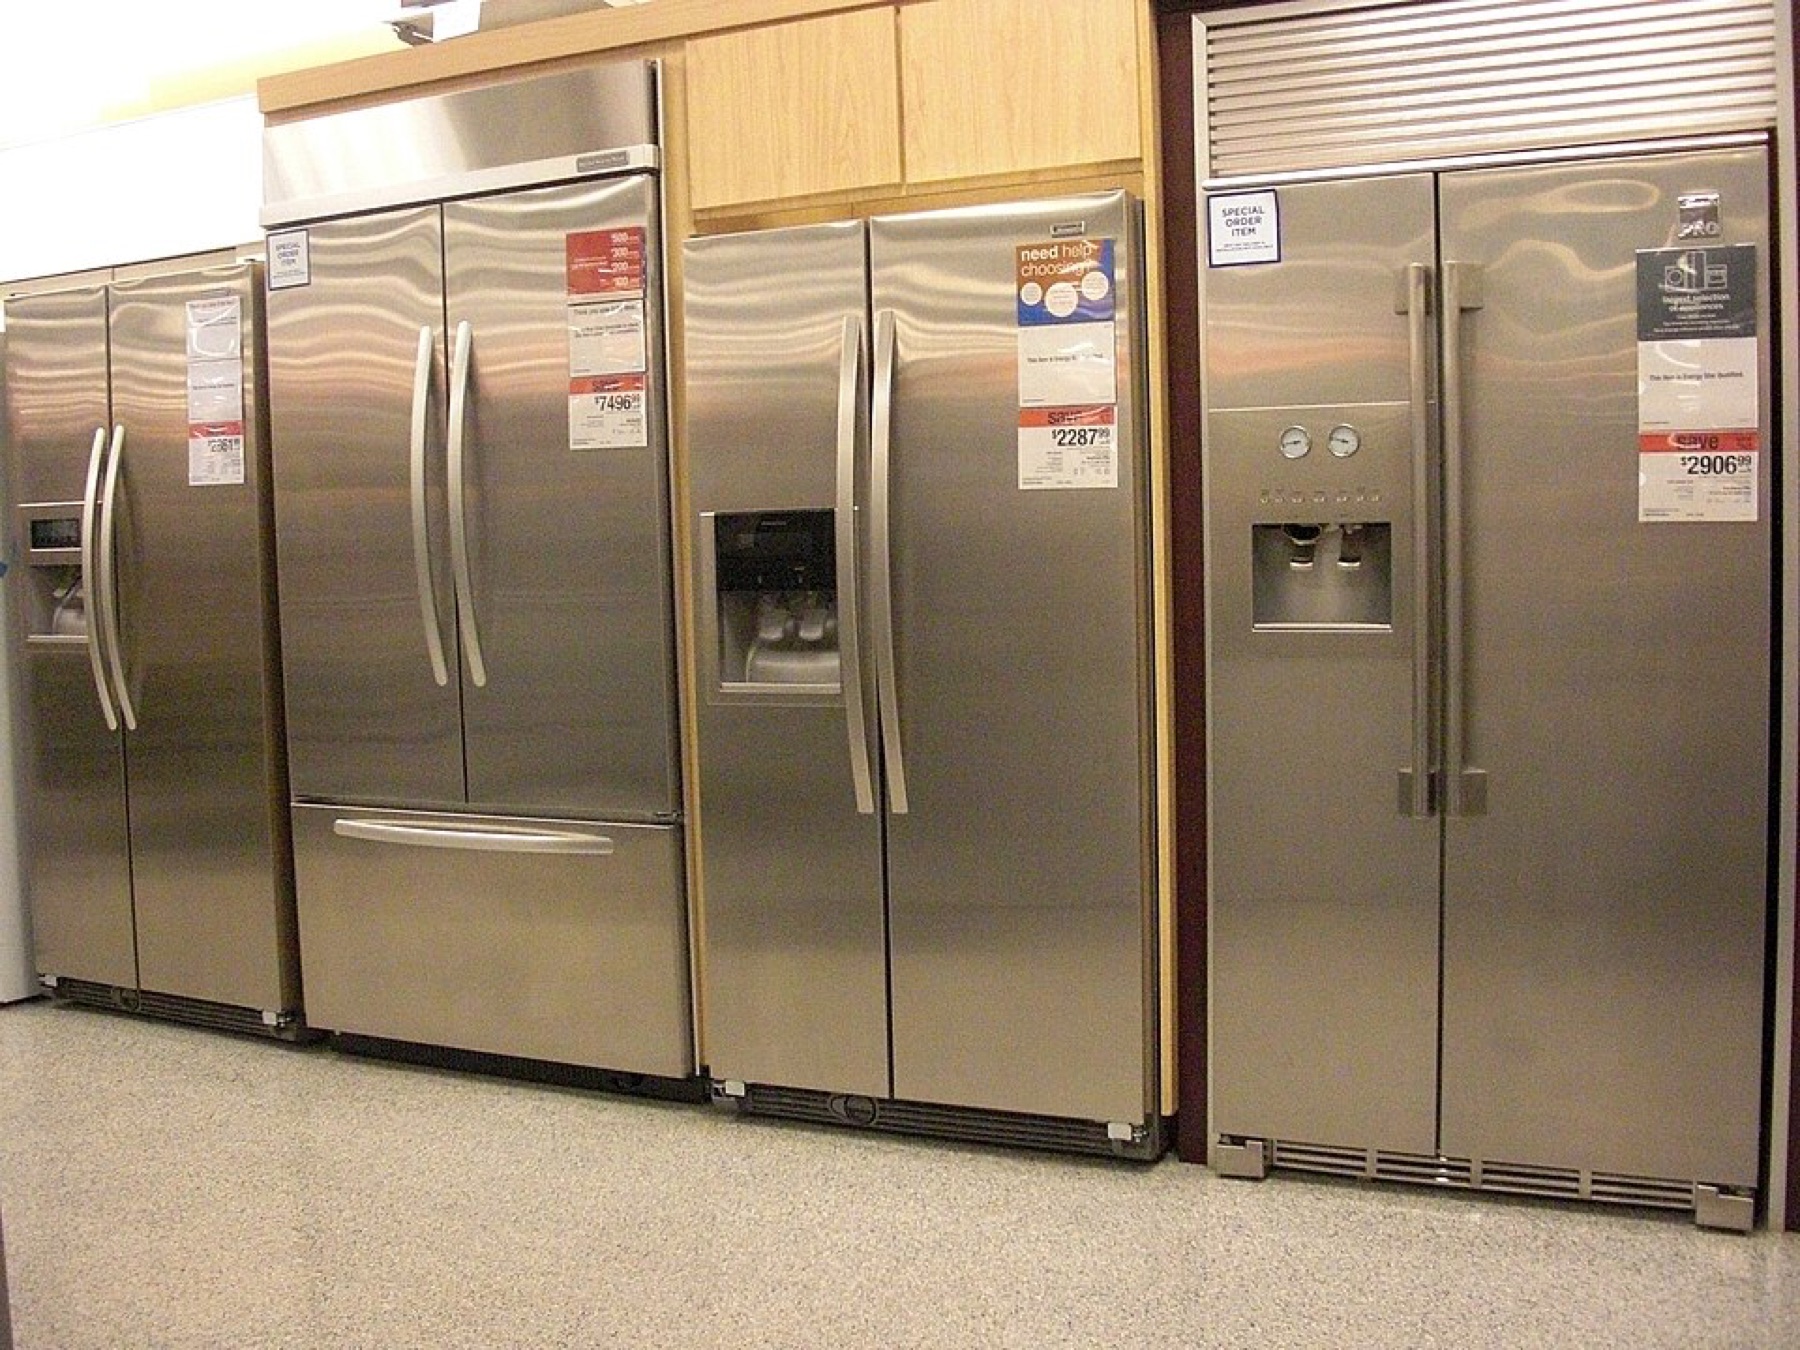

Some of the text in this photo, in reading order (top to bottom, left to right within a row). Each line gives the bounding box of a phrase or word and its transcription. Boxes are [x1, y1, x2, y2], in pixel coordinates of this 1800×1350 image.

[1222, 206, 1265, 217] SPECIAL
[1225, 216, 1262, 227] ORDER
[1231, 227, 1256, 236] ITEM
[1021, 243, 1092, 261] need help
